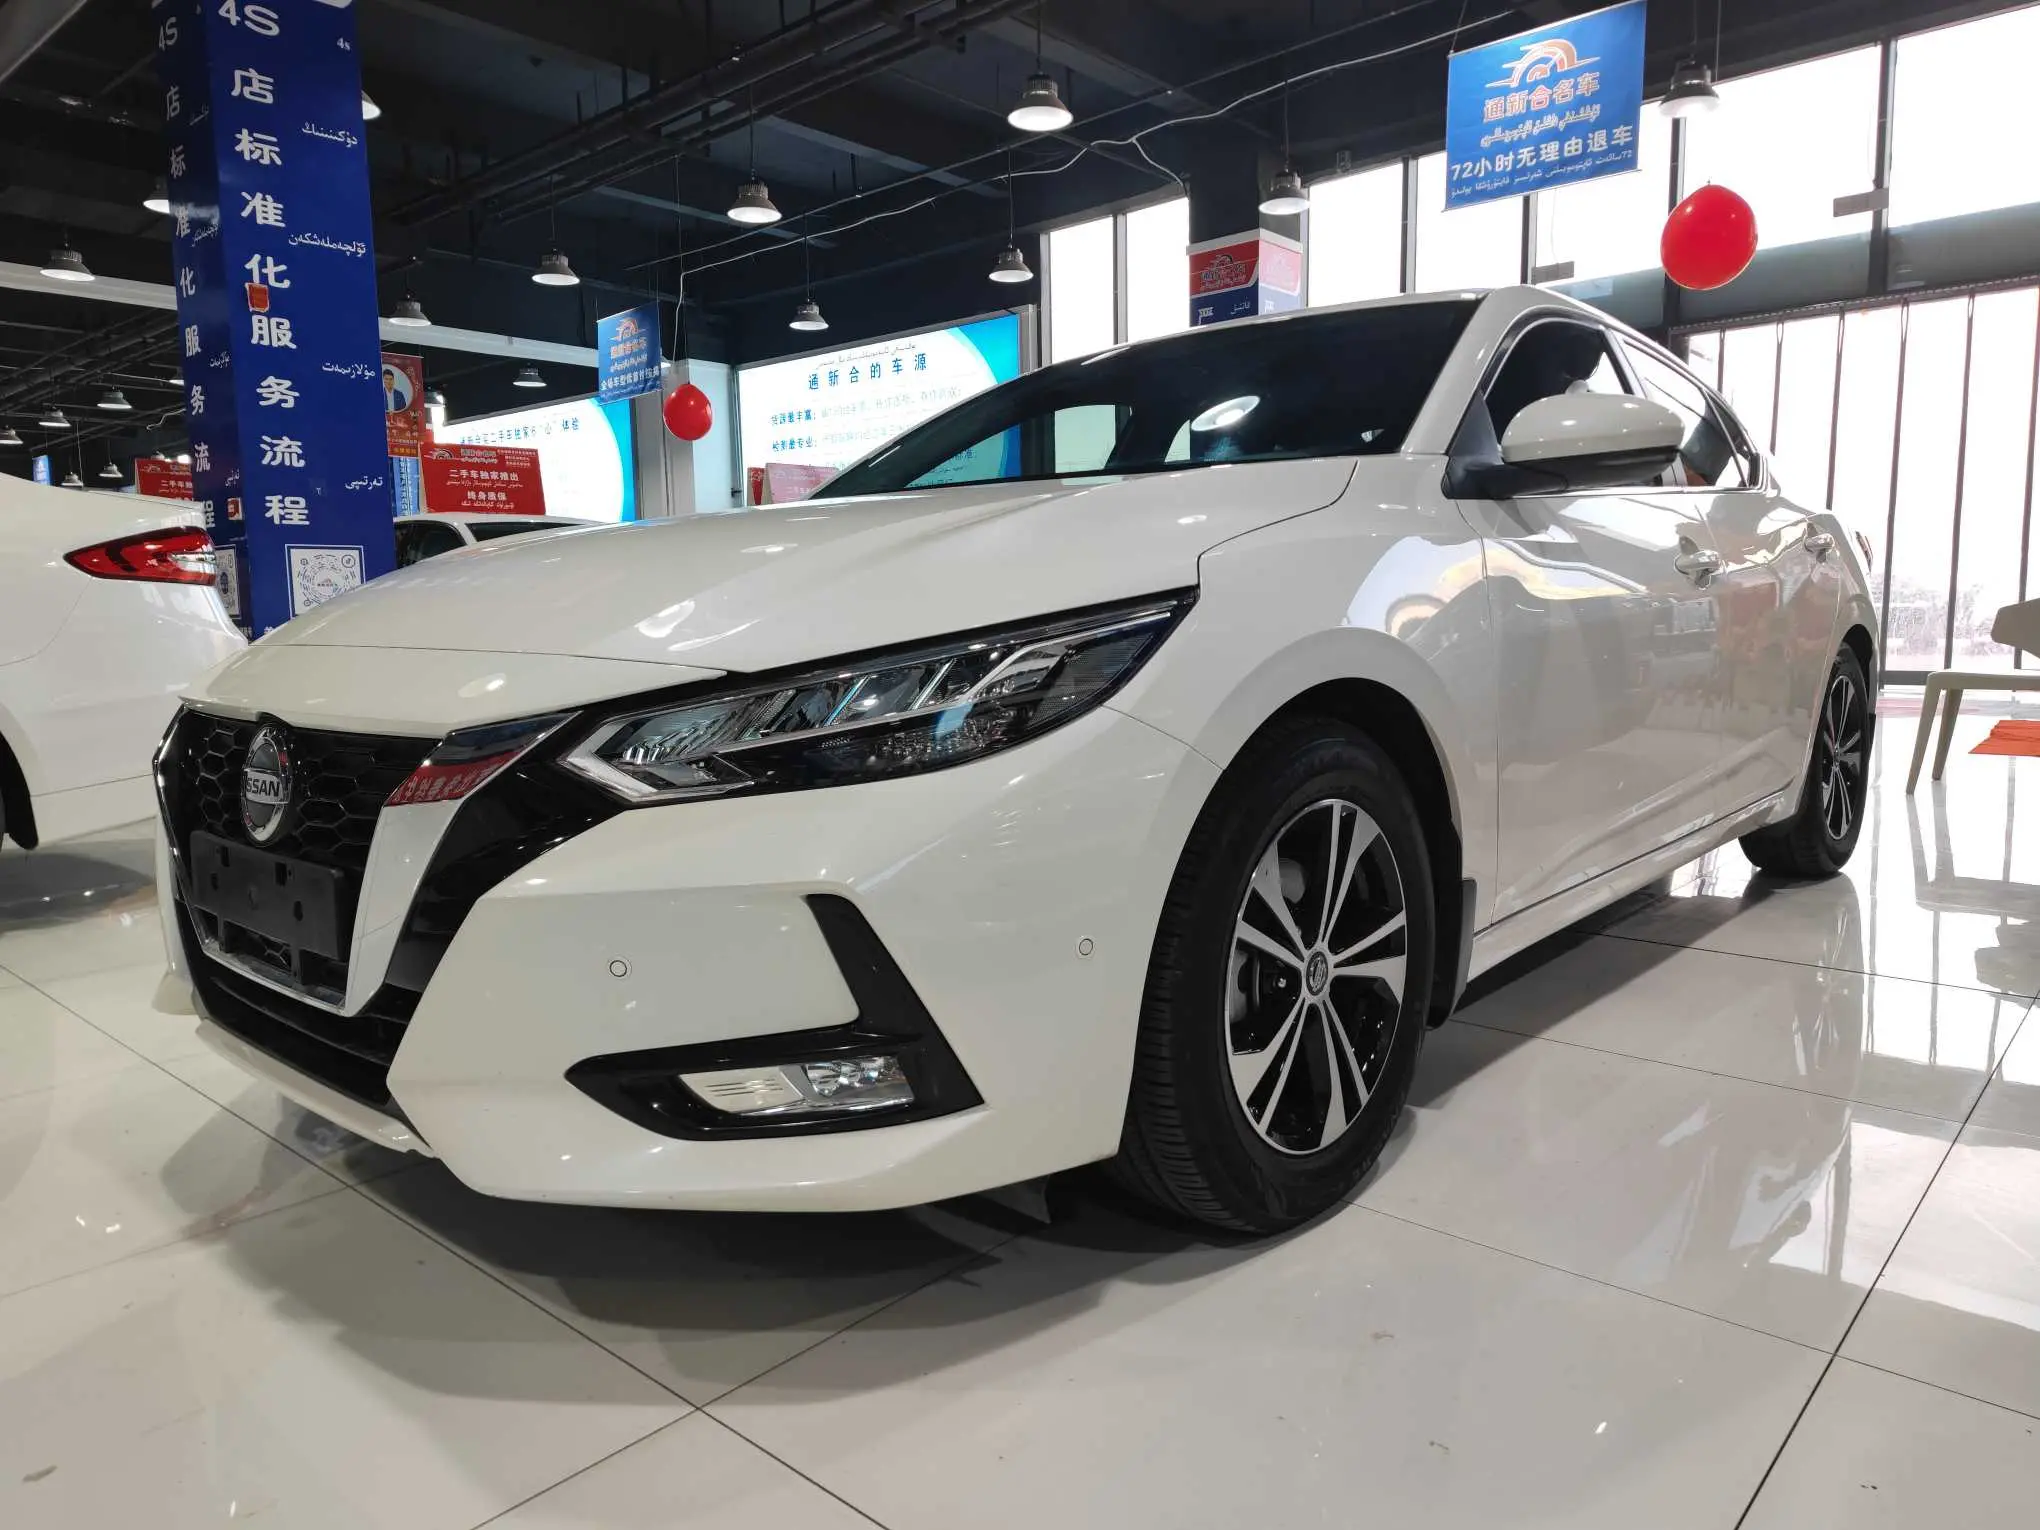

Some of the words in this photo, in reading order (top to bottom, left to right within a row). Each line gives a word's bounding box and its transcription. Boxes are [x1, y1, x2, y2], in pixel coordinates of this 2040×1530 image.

[1451, 124, 1633, 181] 72小时无理由退车
[218, 0, 310, 526] 4S店标准化服务流程
[808, 352, 929, 391] 通新合的车源
